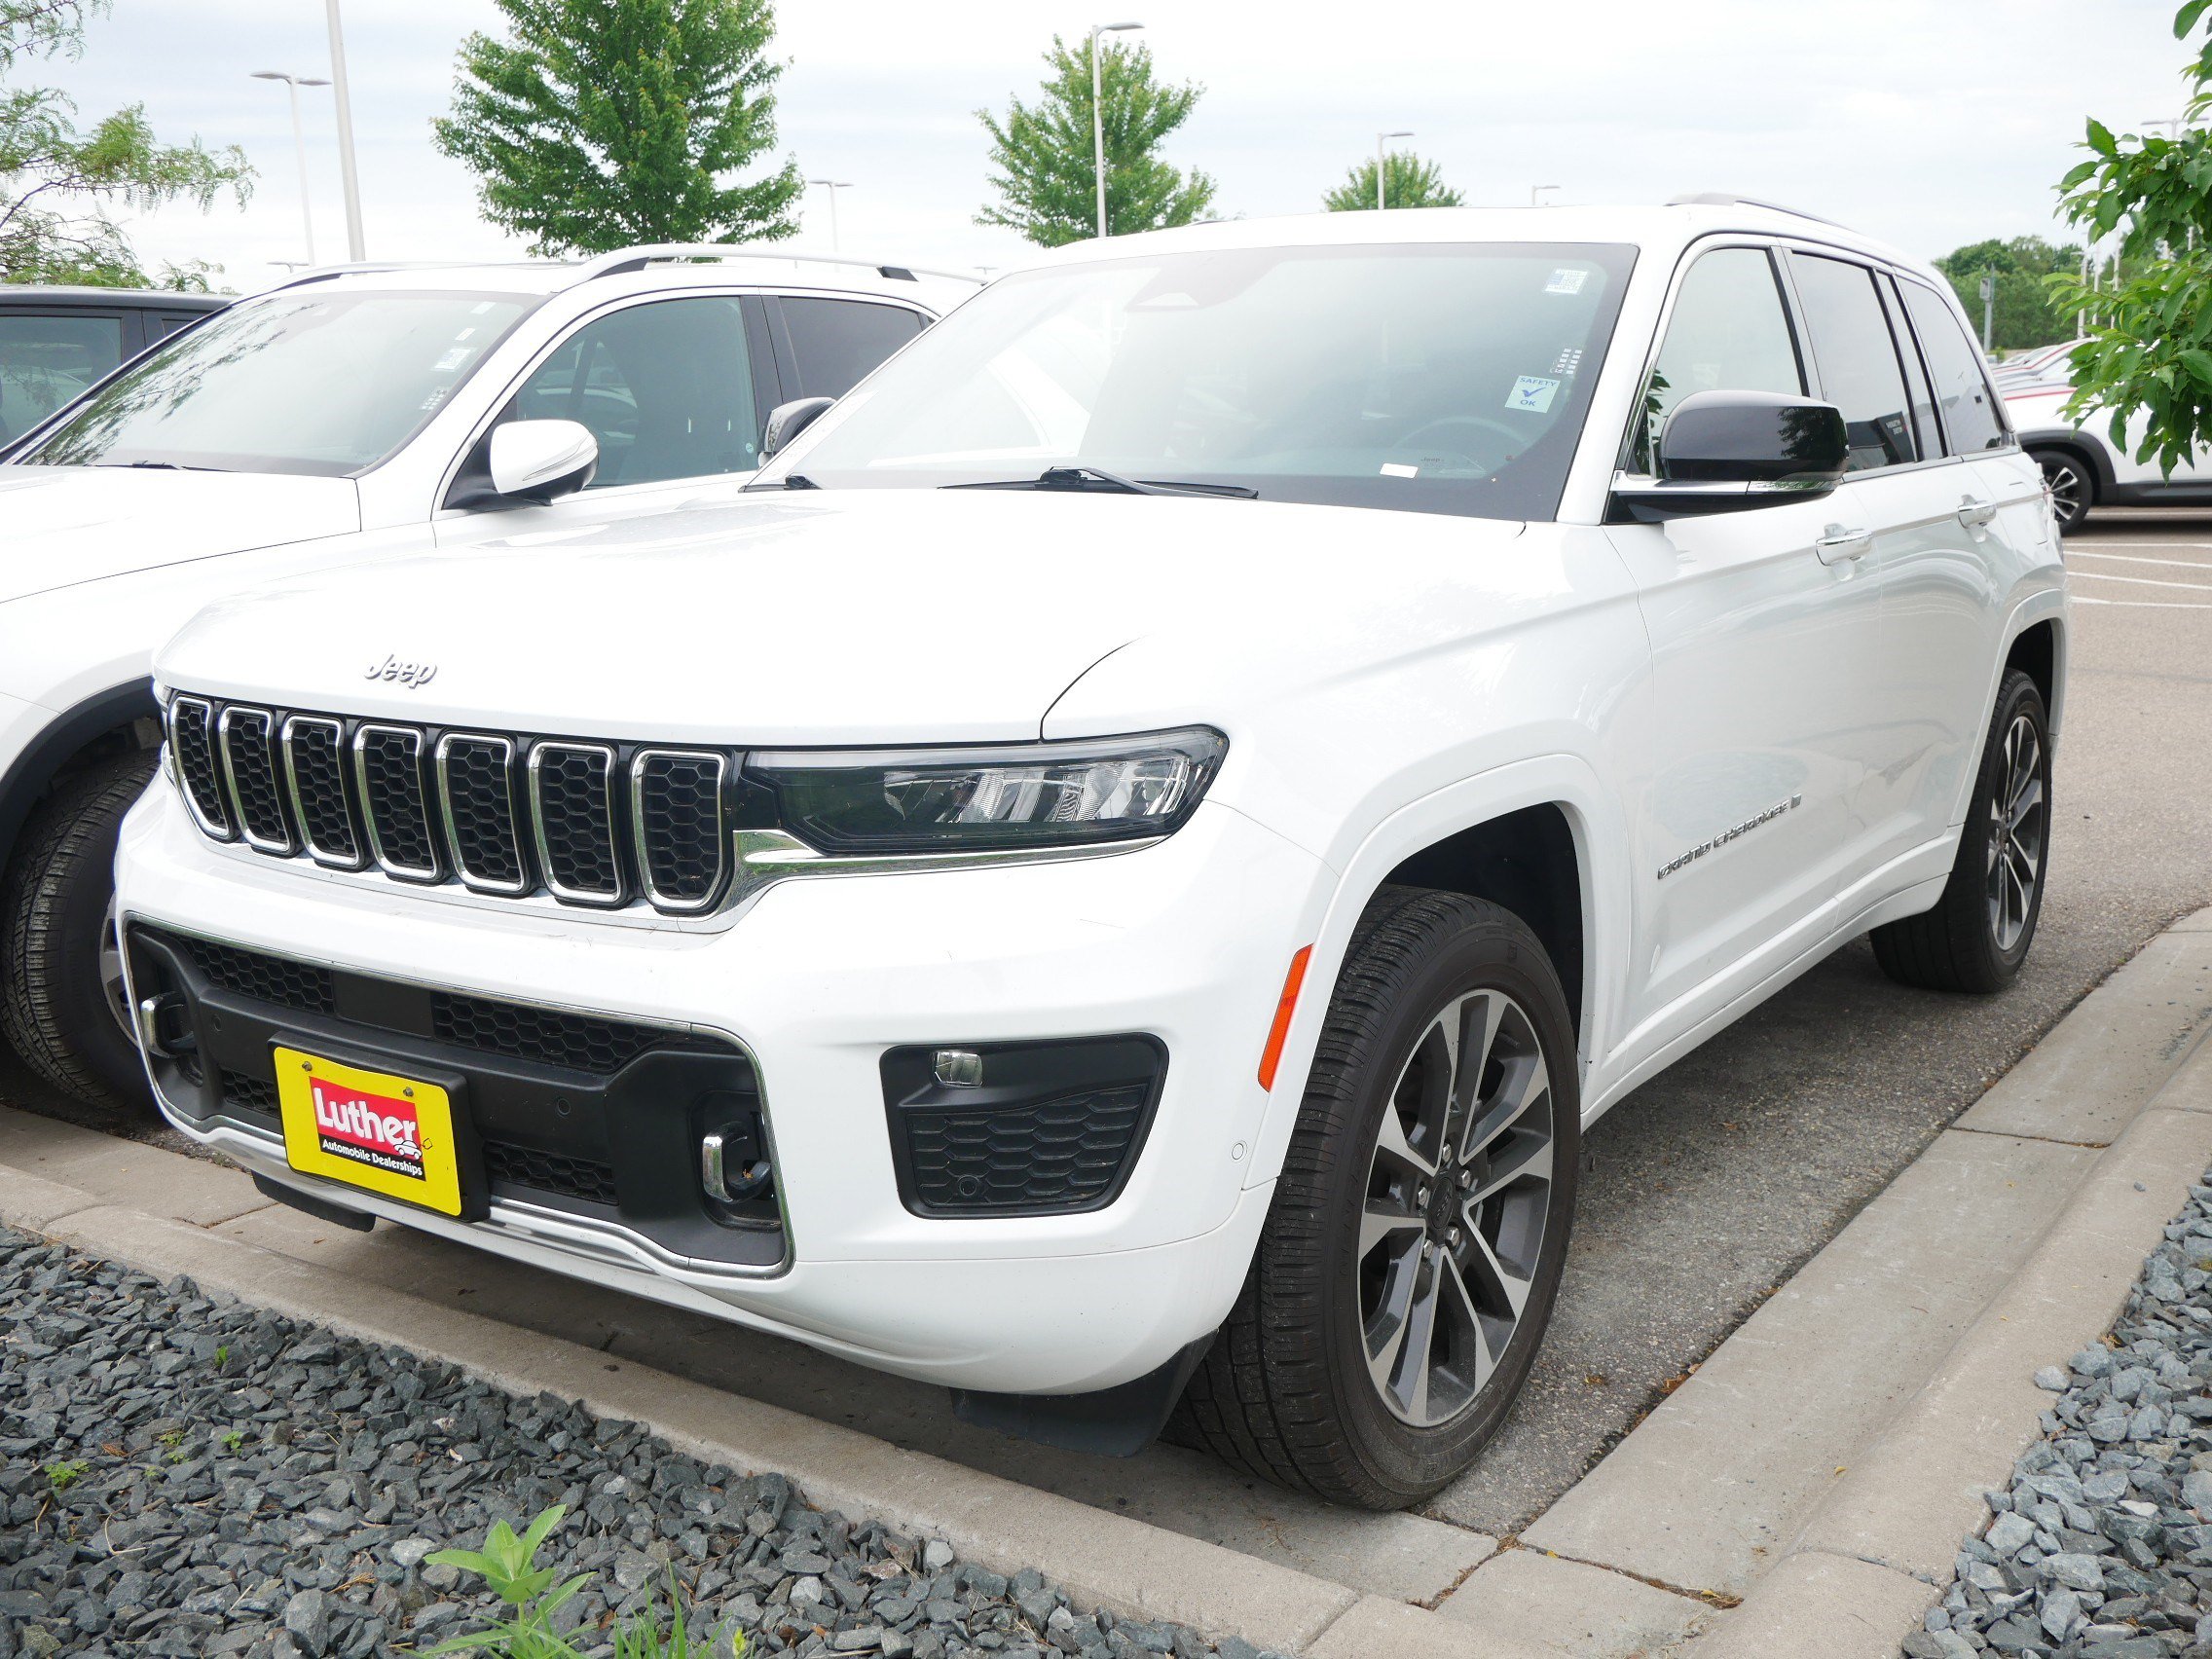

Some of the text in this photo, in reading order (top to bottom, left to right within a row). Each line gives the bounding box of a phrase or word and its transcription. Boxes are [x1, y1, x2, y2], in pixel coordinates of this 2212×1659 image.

[1520, 378, 1557, 387] SAFETY
[363, 653, 438, 690] Jeep
[1658, 799, 1789, 879] GRAND CHEROKEE
[313, 1087, 417, 1146] Luther
[322, 1139, 423, 1175] Automobile Dealerships
